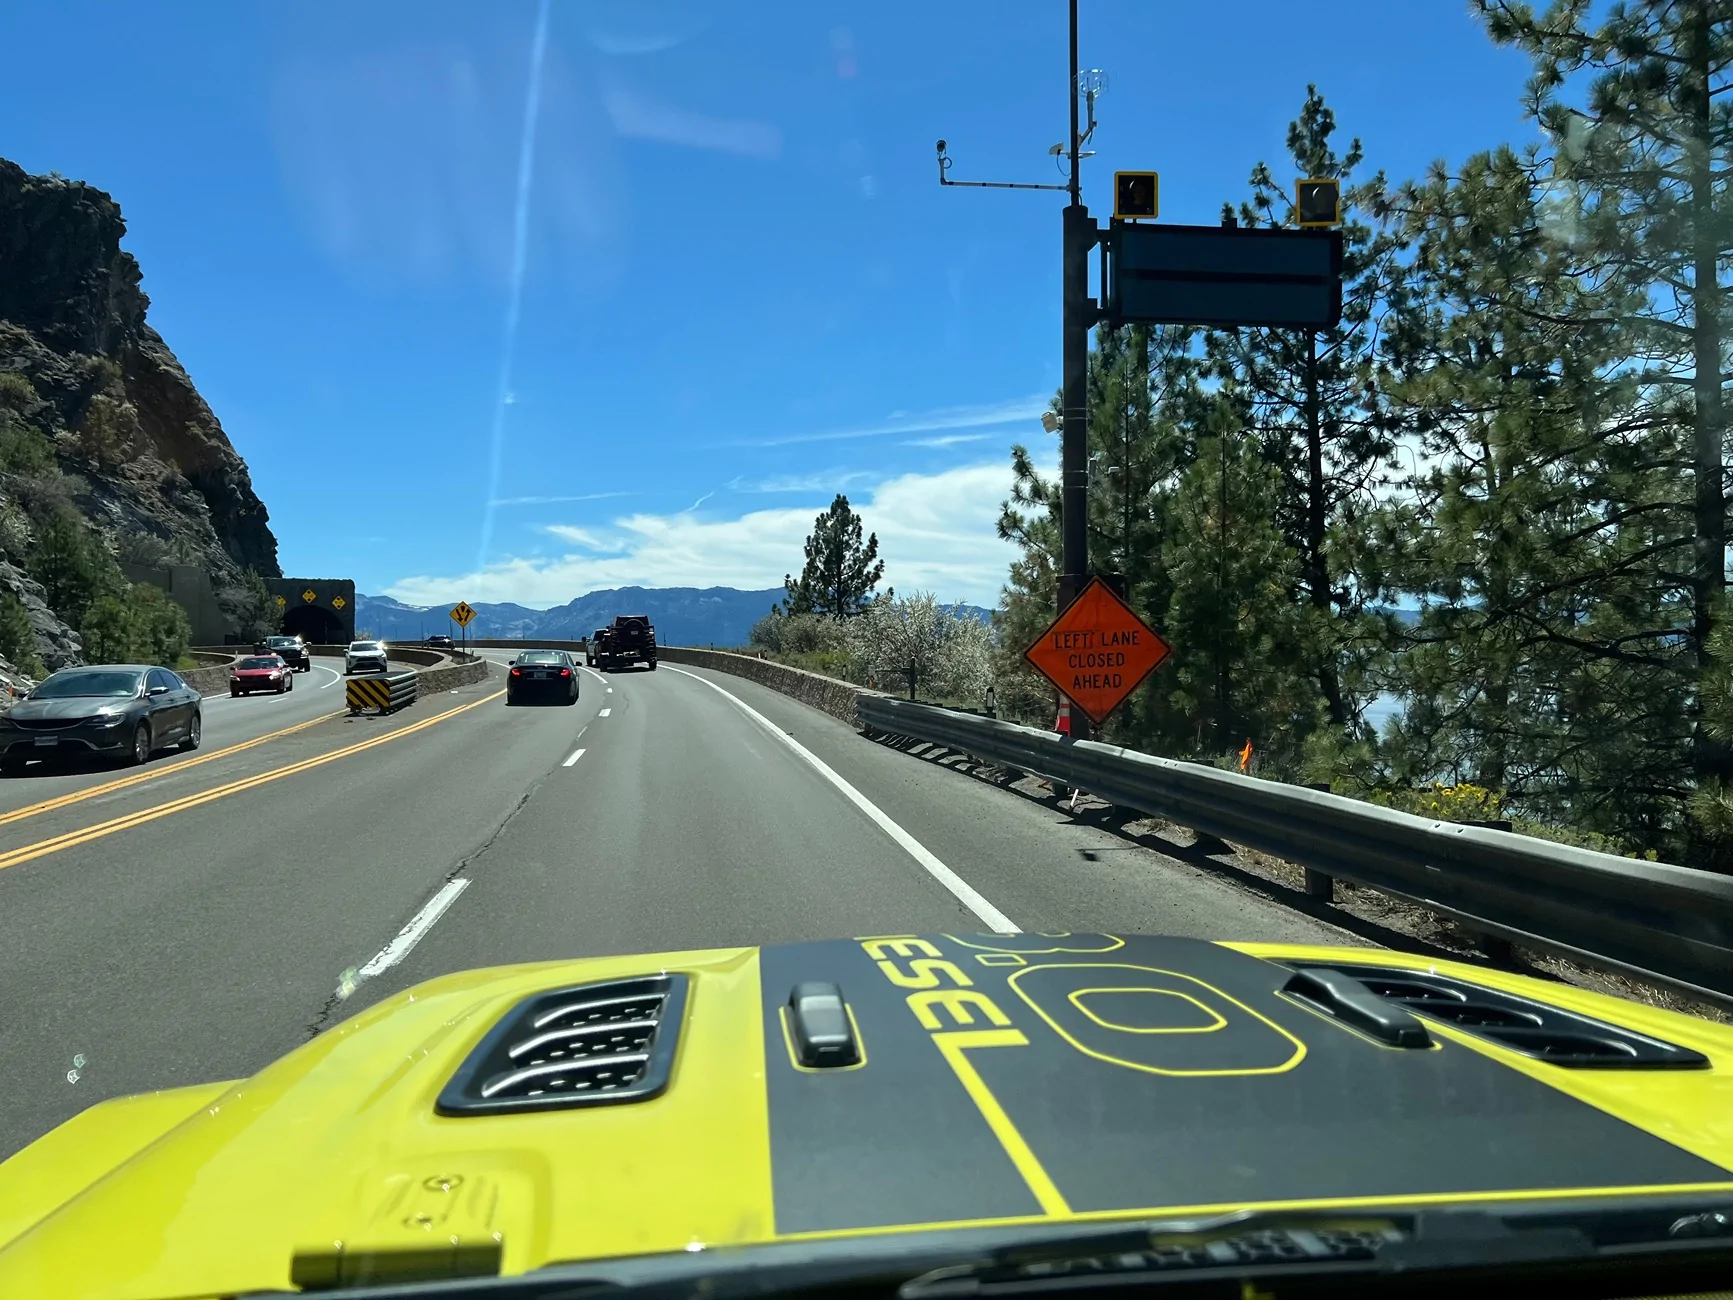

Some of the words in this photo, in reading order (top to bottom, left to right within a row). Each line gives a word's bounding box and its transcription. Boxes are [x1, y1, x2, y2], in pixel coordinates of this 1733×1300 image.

[1054, 632, 1087, 649] LEFT
[1101, 630, 1140, 646] LANE
[1068, 652, 1125, 669] CLOSED
[1073, 673, 1122, 690] AHEAD
